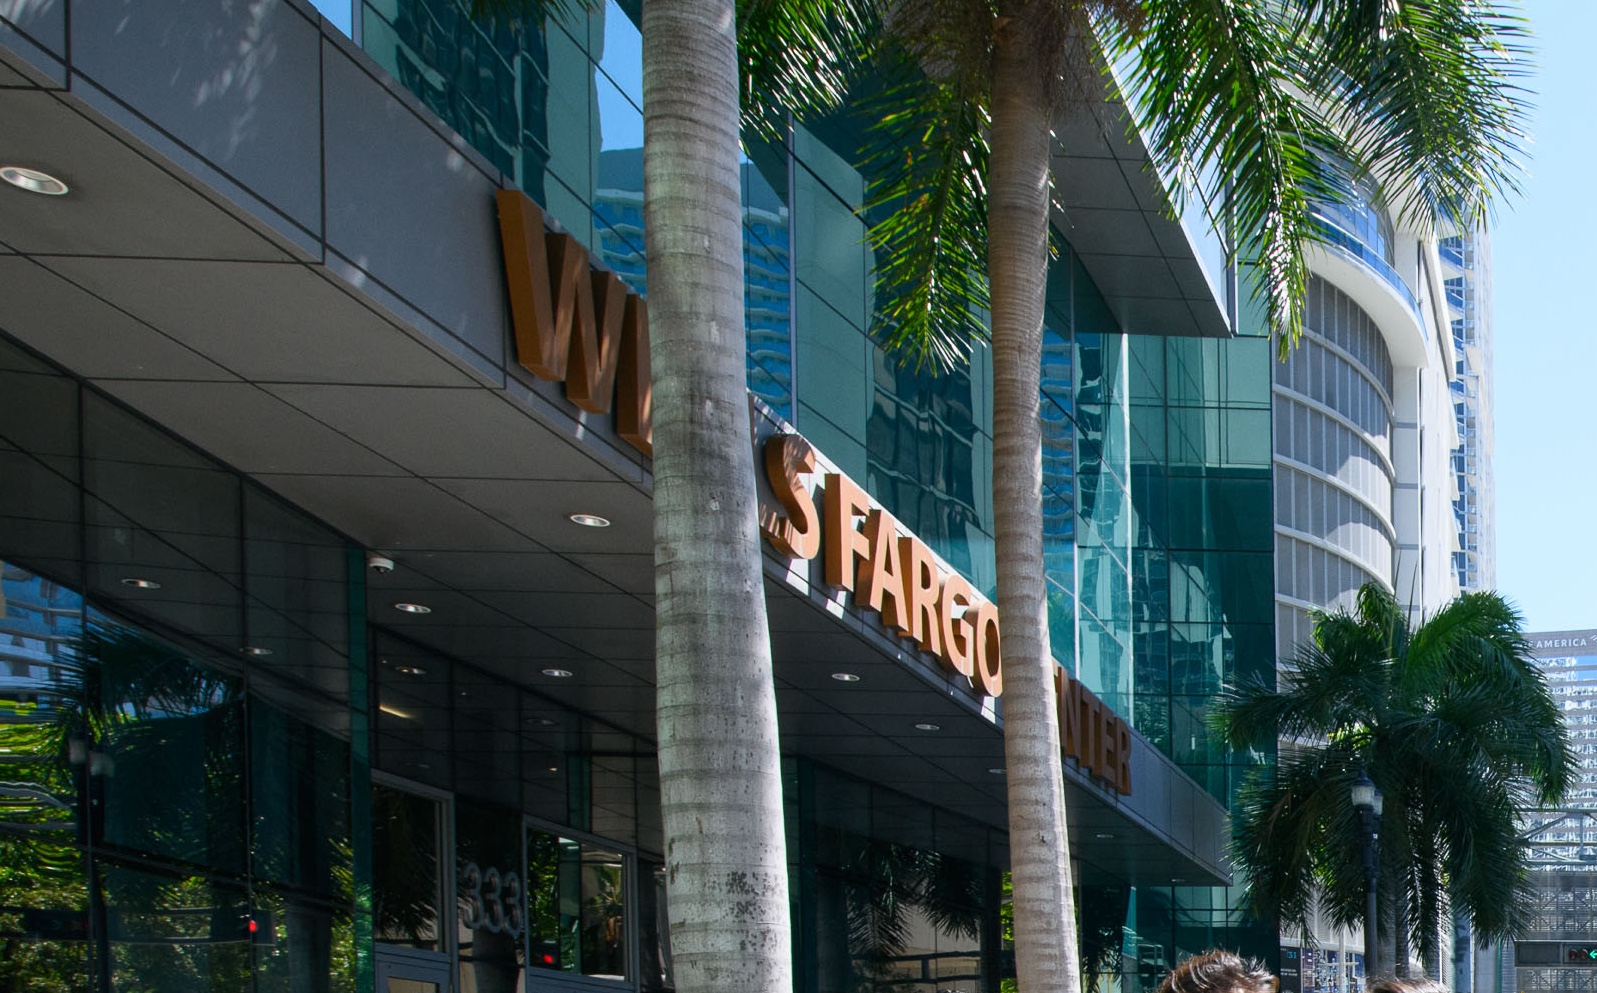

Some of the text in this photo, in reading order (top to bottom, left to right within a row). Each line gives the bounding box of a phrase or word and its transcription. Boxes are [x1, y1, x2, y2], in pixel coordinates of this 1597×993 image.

[1536, 638, 1587, 649] AMERICA
[1052, 659, 1132, 797] NTER
[463, 862, 522, 938] 333
